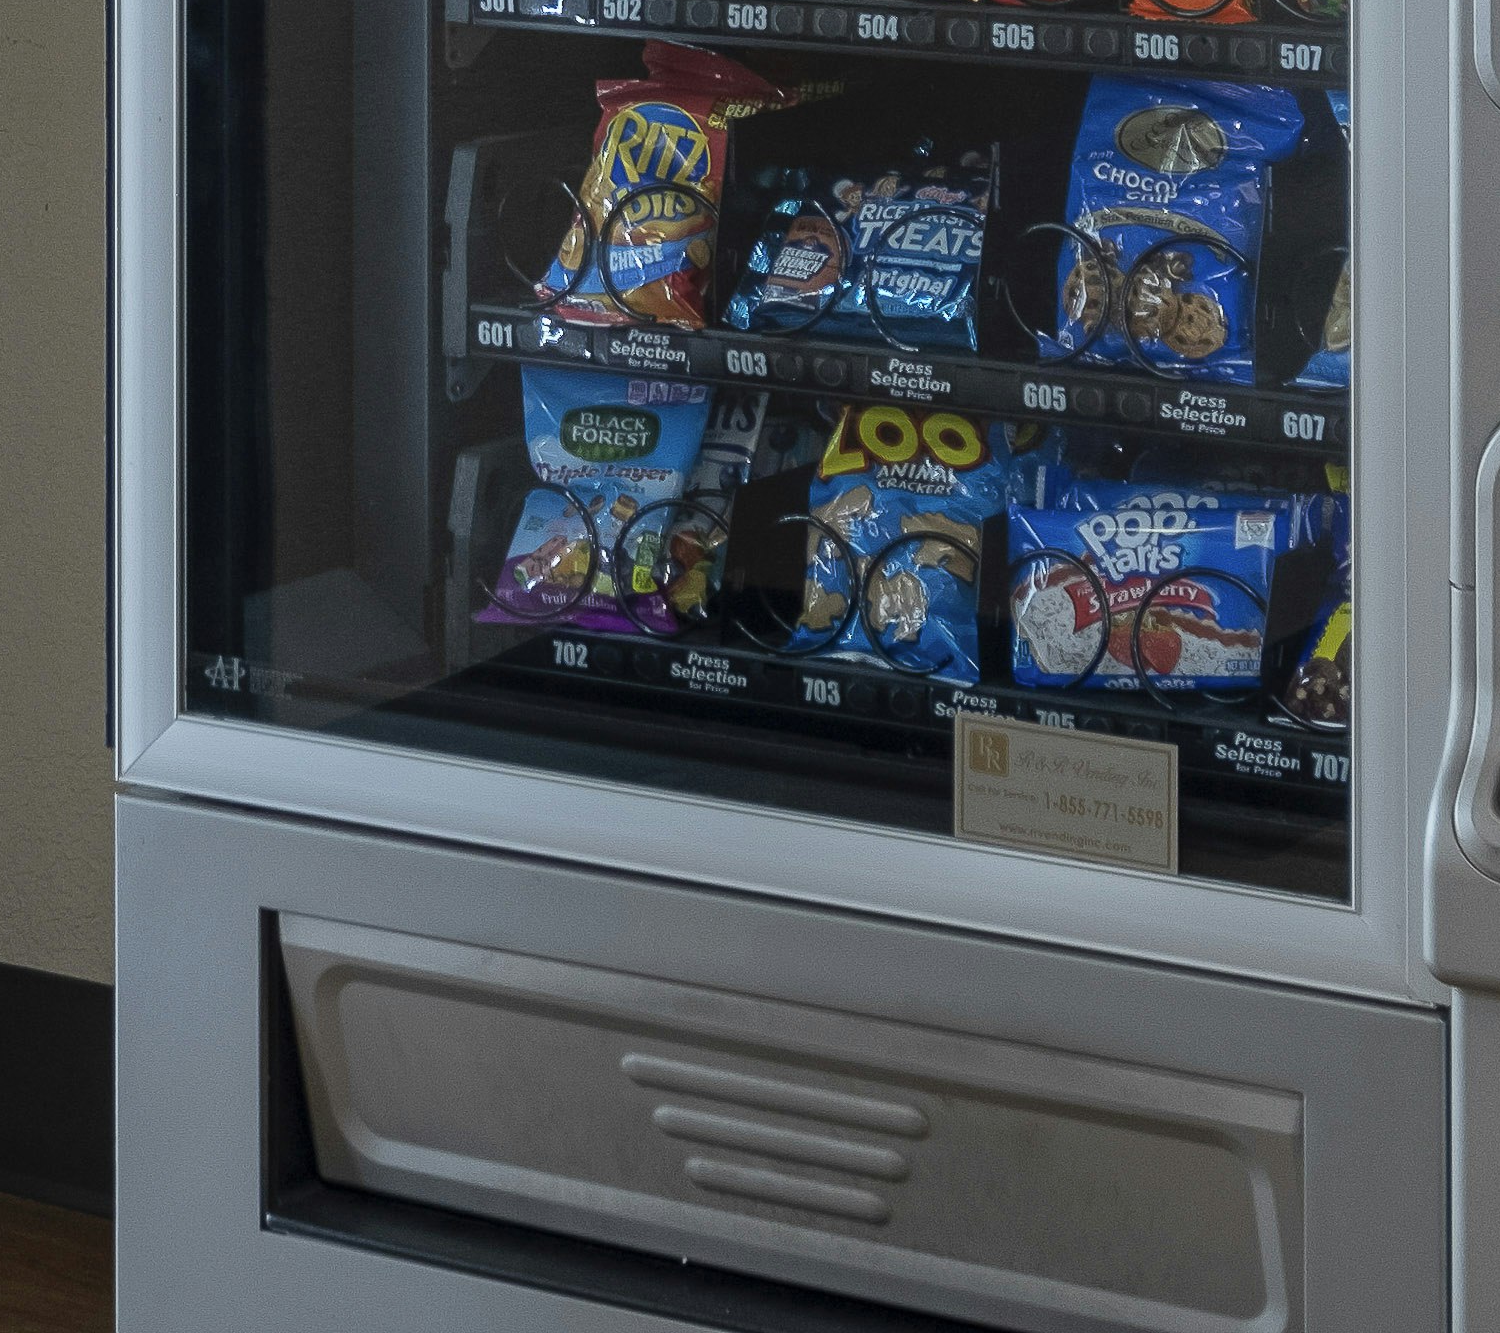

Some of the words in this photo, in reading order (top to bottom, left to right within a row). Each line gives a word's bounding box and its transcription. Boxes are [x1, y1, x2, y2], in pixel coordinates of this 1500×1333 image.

[727, 4, 769, 30] 503
[858, 14, 899, 39] 504
[992, 22, 1035, 49] 505
[1134, 32, 1180, 60] 506
[1280, 42, 1323, 70] 507
[604, 110, 710, 195] RITZ
[859, 202, 908, 222] RICE
[858, 219, 984, 258] TREATS
[478, 322, 513, 348] 601
[628, 329, 672, 347] Press
[610, 342, 687, 362] Selection
[725, 350, 768, 376] 603
[888, 358, 933, 376] Press
[870, 371, 952, 394] Selection
[890, 388, 904, 399] for
[906, 389, 934, 402] Price
[1022, 382, 1067, 412] 605
[1180, 390, 1228, 410] Press
[579, 412, 648, 432] BLACK
[1160, 403, 1247, 427] Selection
[1283, 411, 1327, 442] 607
[571, 425, 651, 449] FOREST
[603, 463, 672, 483] Layer
[553, 640, 589, 669] 702
[688, 650, 731, 670] Press
[671, 663, 748, 688] Selection
[802, 676, 841, 706] 703
[953, 691, 998, 710] Press
[1234, 734, 1283, 752] Press
[1214, 747, 1301, 772] Selection
[1312, 753, 1348, 780] 707
